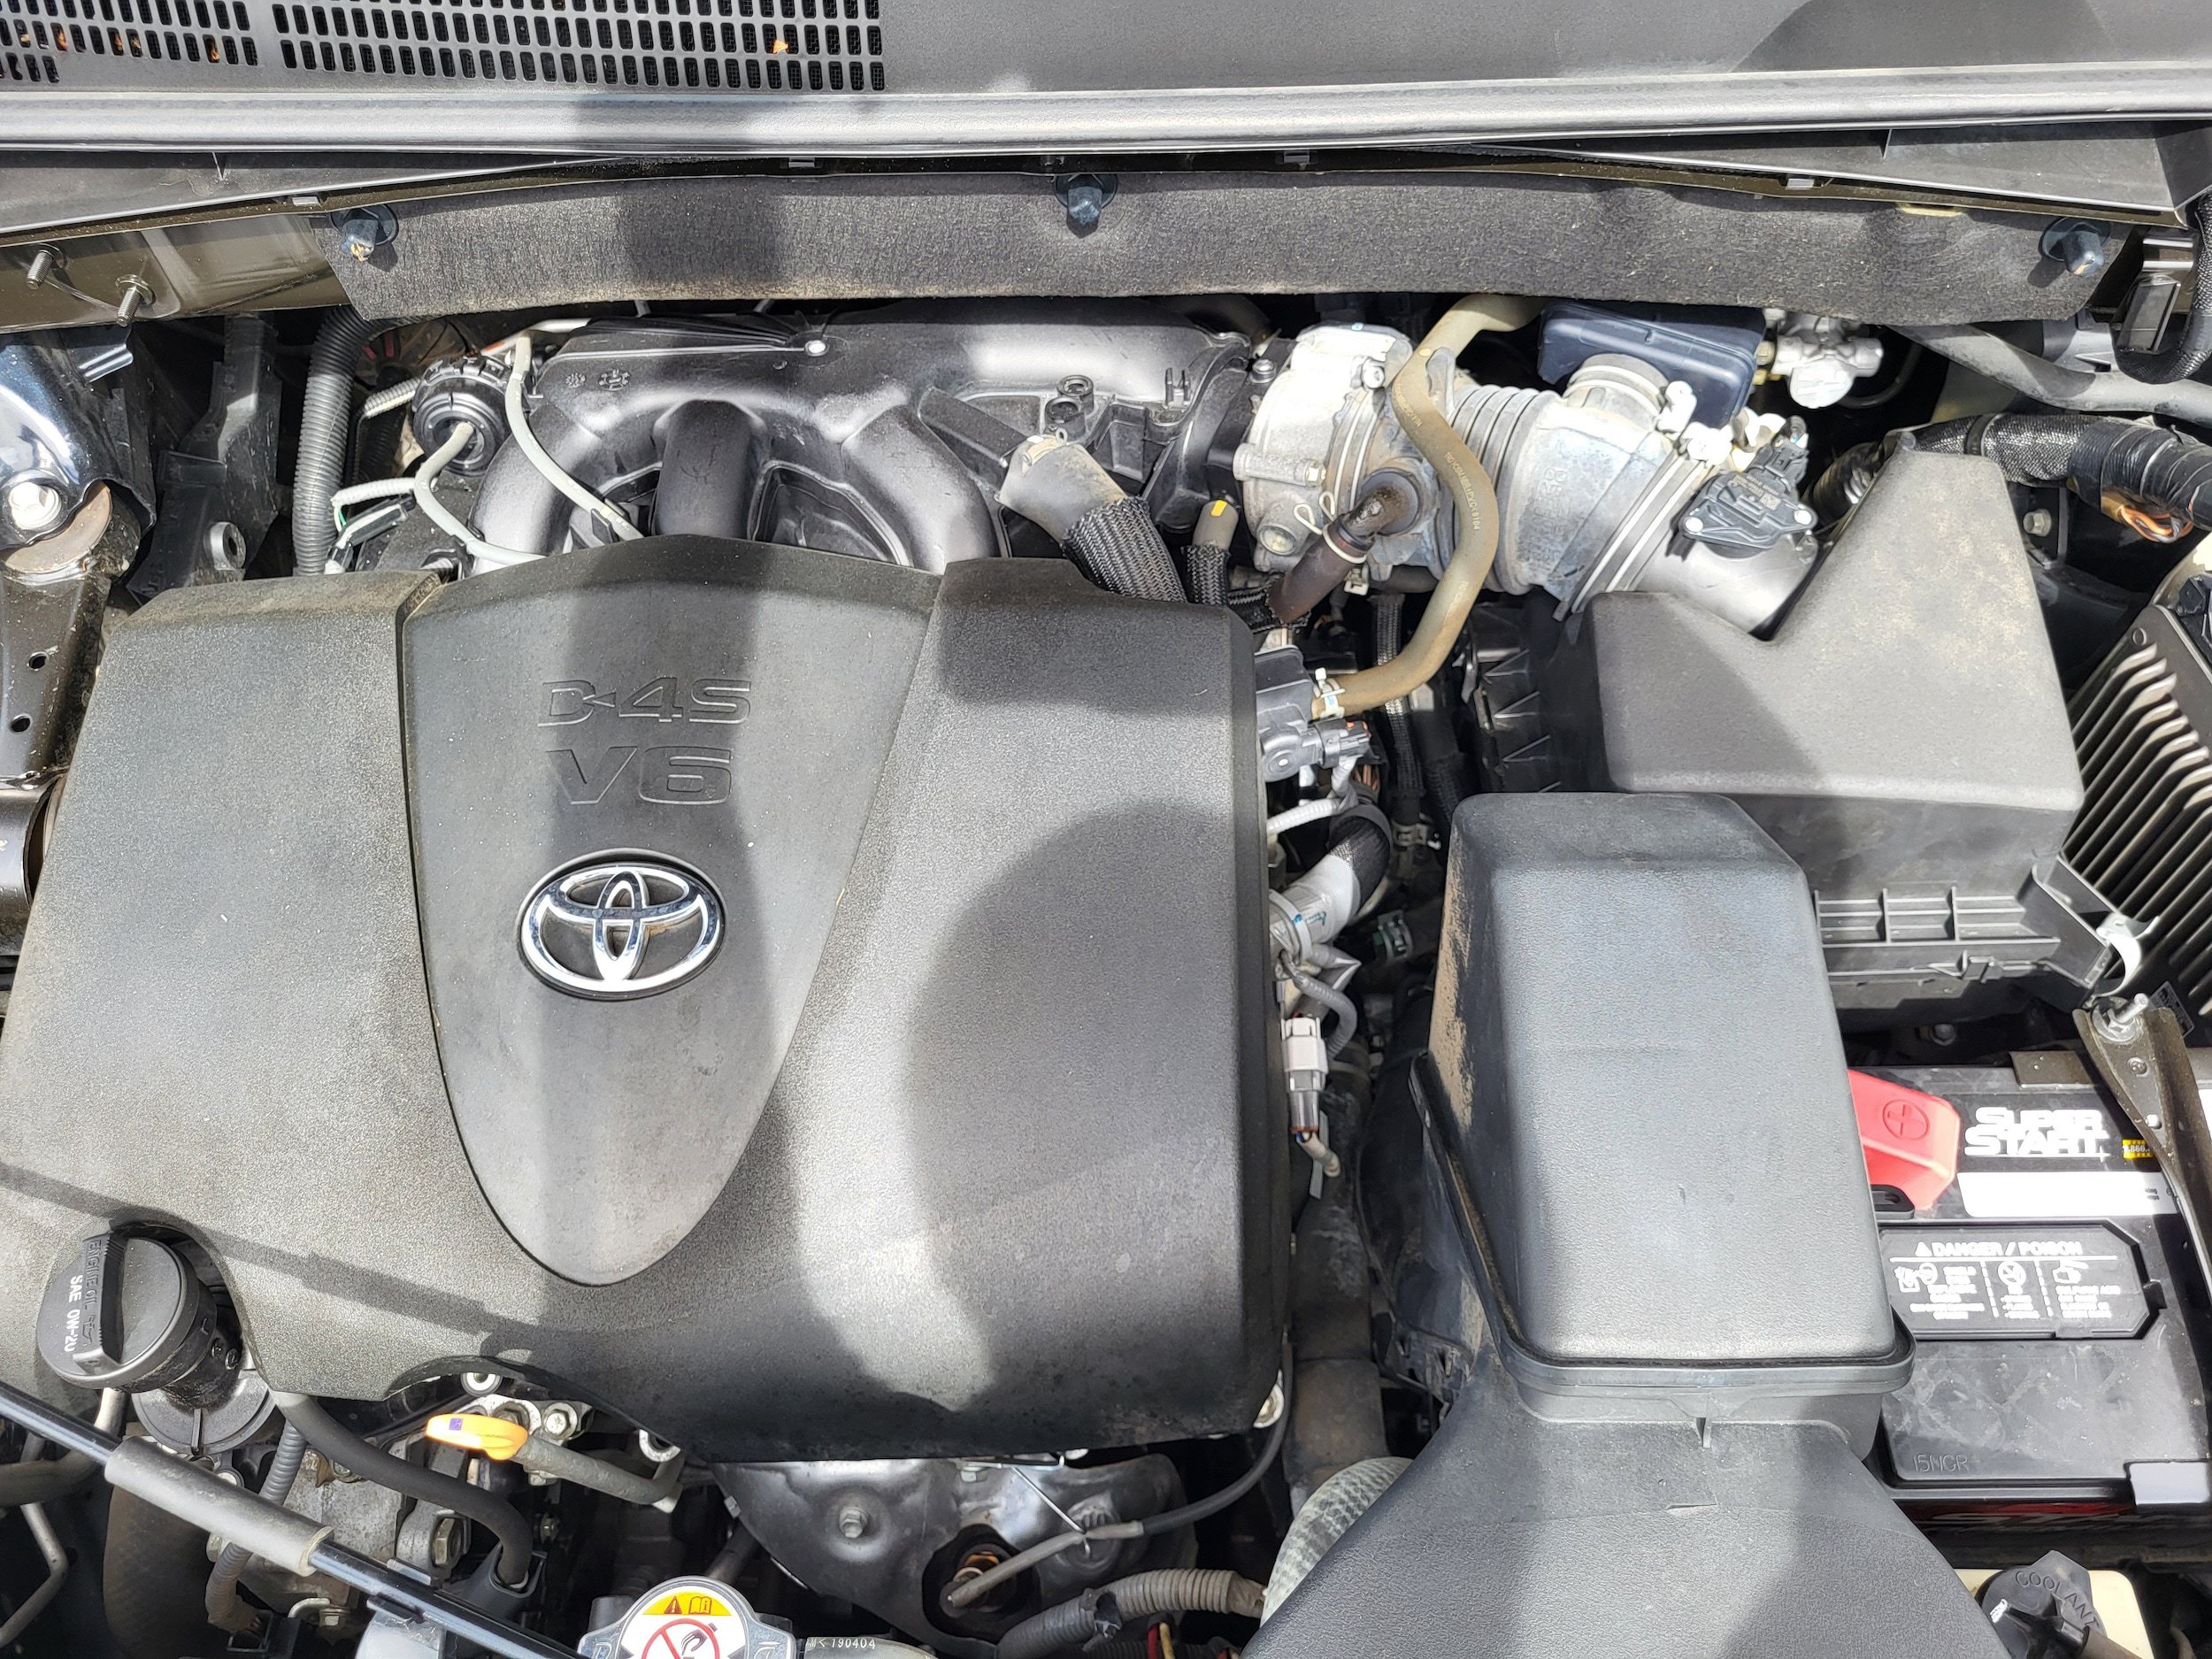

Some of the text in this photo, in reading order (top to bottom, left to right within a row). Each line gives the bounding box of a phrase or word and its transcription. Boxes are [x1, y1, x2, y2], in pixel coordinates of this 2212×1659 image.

[545, 746, 733, 805] V6
[1964, 1128, 2111, 1158] START
[1974, 1106, 2109, 1138] SUPER
[1931, 1241, 2004, 1256] DANGER
[2017, 1240, 2084, 1256] POISON
[84, 1240, 102, 1310] ENGINE OIL
[64, 1274, 84, 1352] SAE 0W-20
[2015, 1571, 2101, 1629] COOLANT
[831, 1638, 876, 1650] 190404
